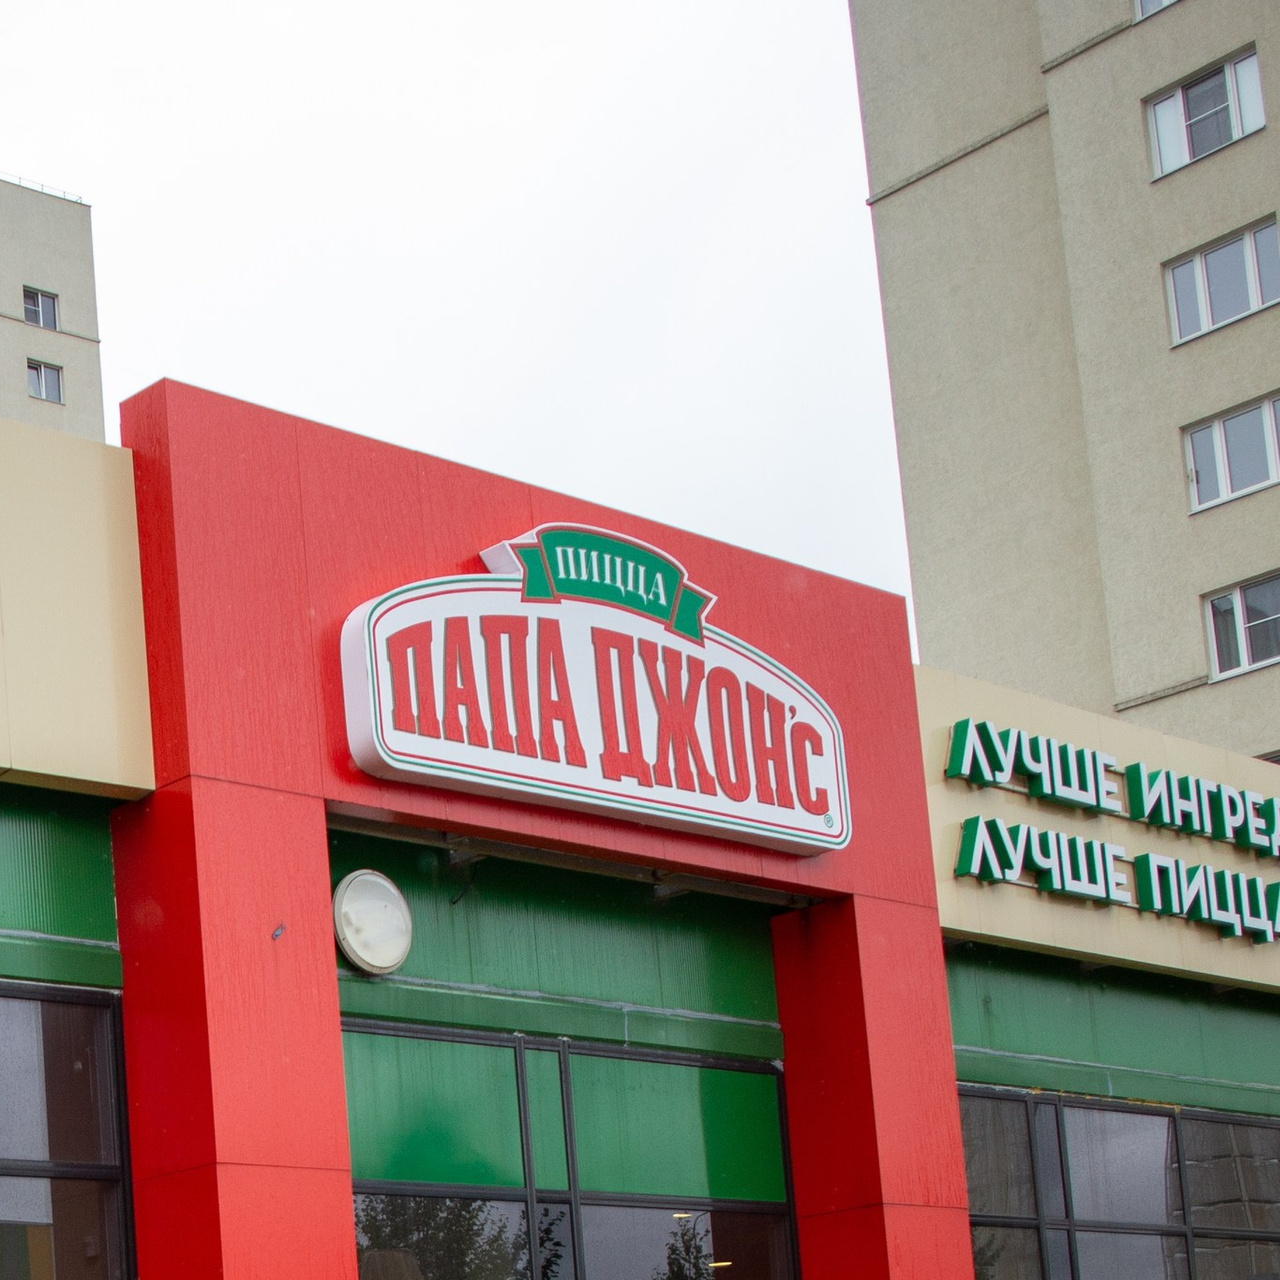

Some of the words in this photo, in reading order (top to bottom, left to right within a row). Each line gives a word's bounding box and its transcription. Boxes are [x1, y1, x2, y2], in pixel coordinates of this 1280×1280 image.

[554, 545, 668, 606] ПИЦЦА
[385, 614, 587, 768] ПАПА
[946, 717, 1122, 813] ЛУЧШЕ
[956, 815, 1131, 903] ЛУЧШЕ
[1134, 853, 1280, 944] ПИЦЦ
